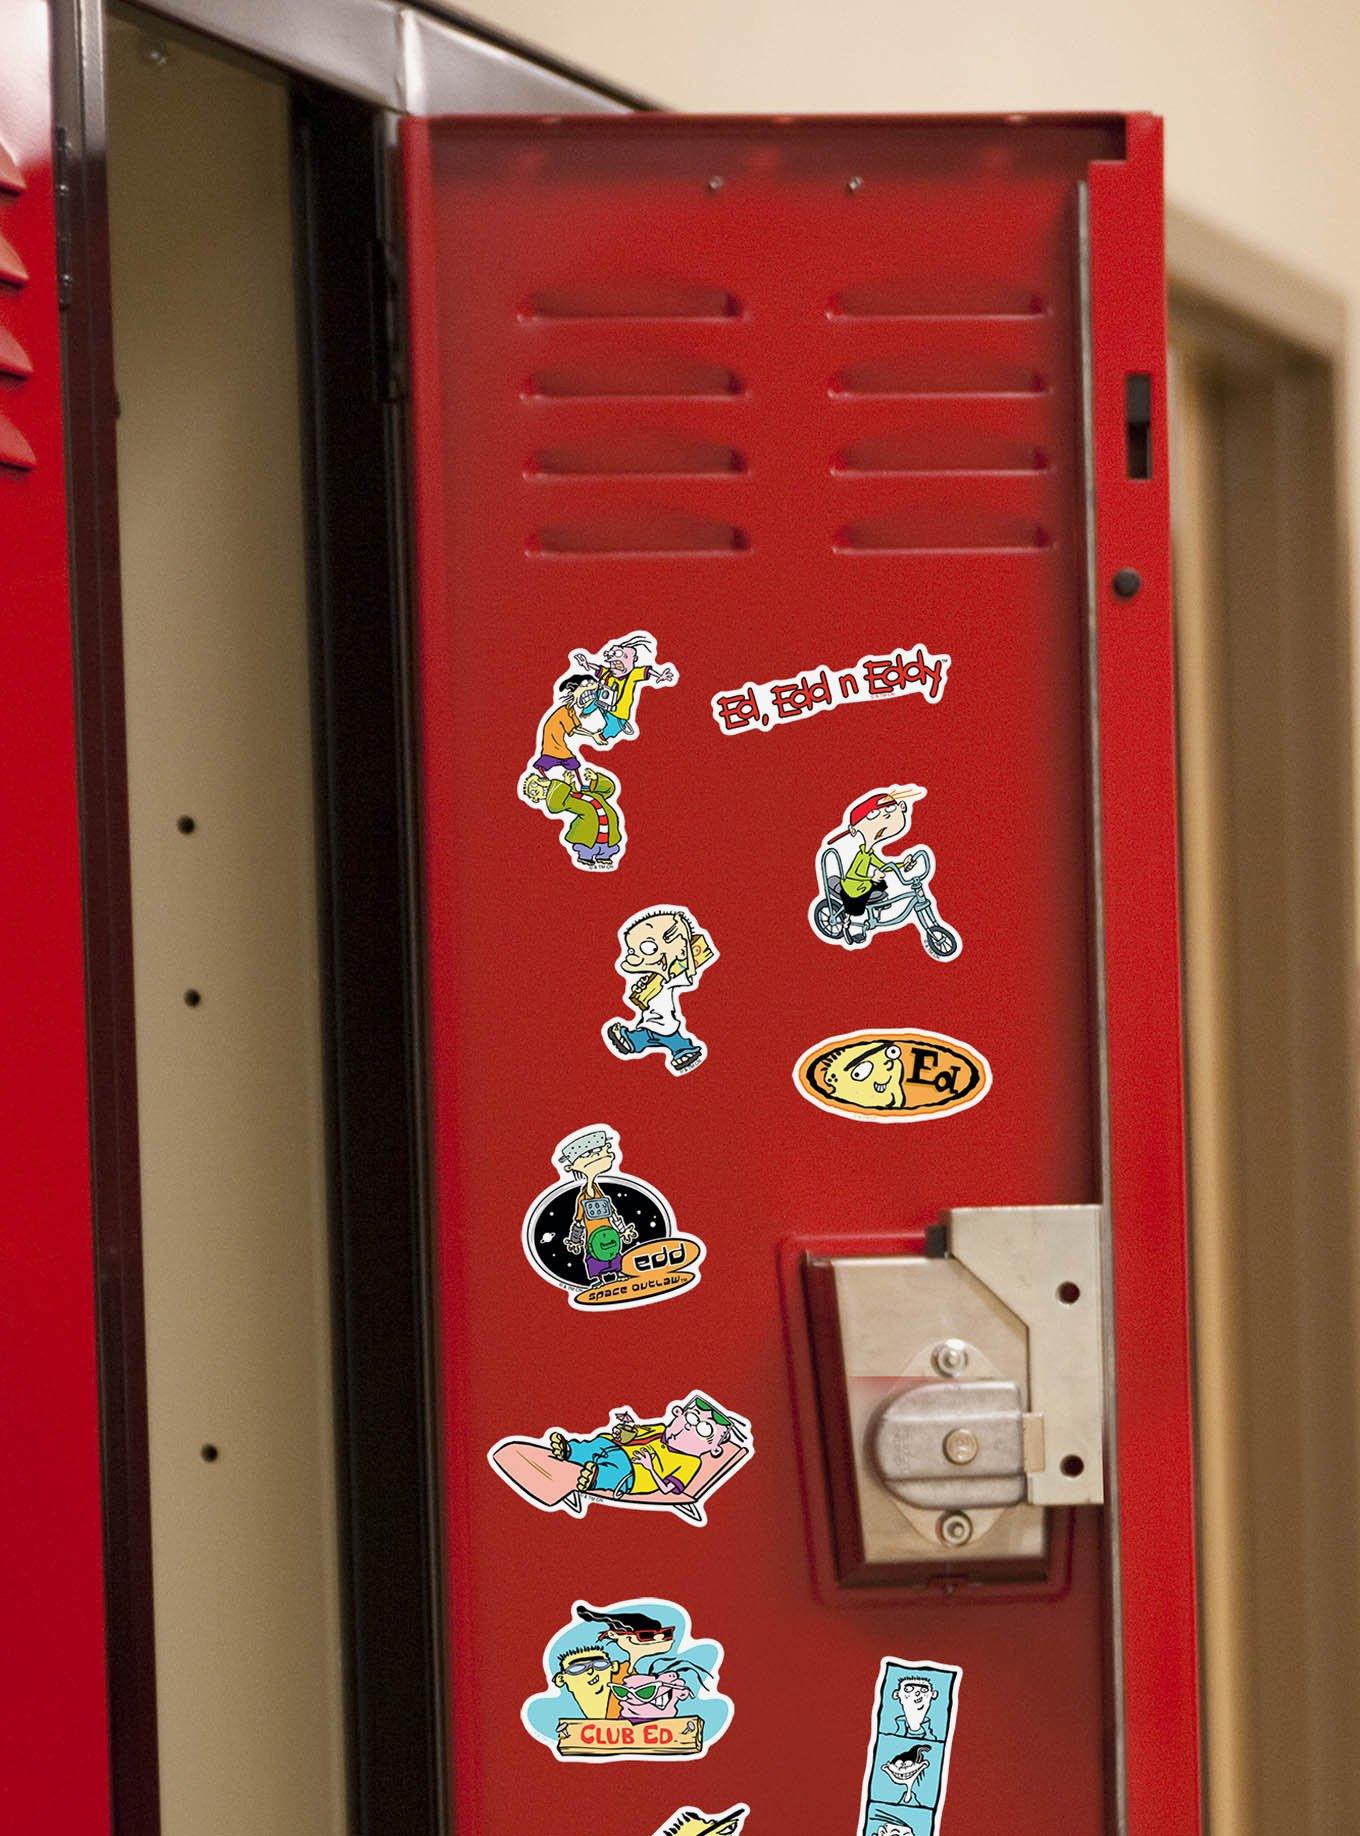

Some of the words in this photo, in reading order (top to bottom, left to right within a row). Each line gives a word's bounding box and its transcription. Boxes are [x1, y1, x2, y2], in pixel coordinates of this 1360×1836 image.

[717, 687, 769, 730] Ed,
[770, 670, 832, 718] Edd
[839, 673, 859, 698] n
[863, 649, 942, 698] Eddy
[906, 1047, 961, 1094] Ed
[588, 1286, 628, 1302] space
[580, 1724, 635, 1745] CLUB
